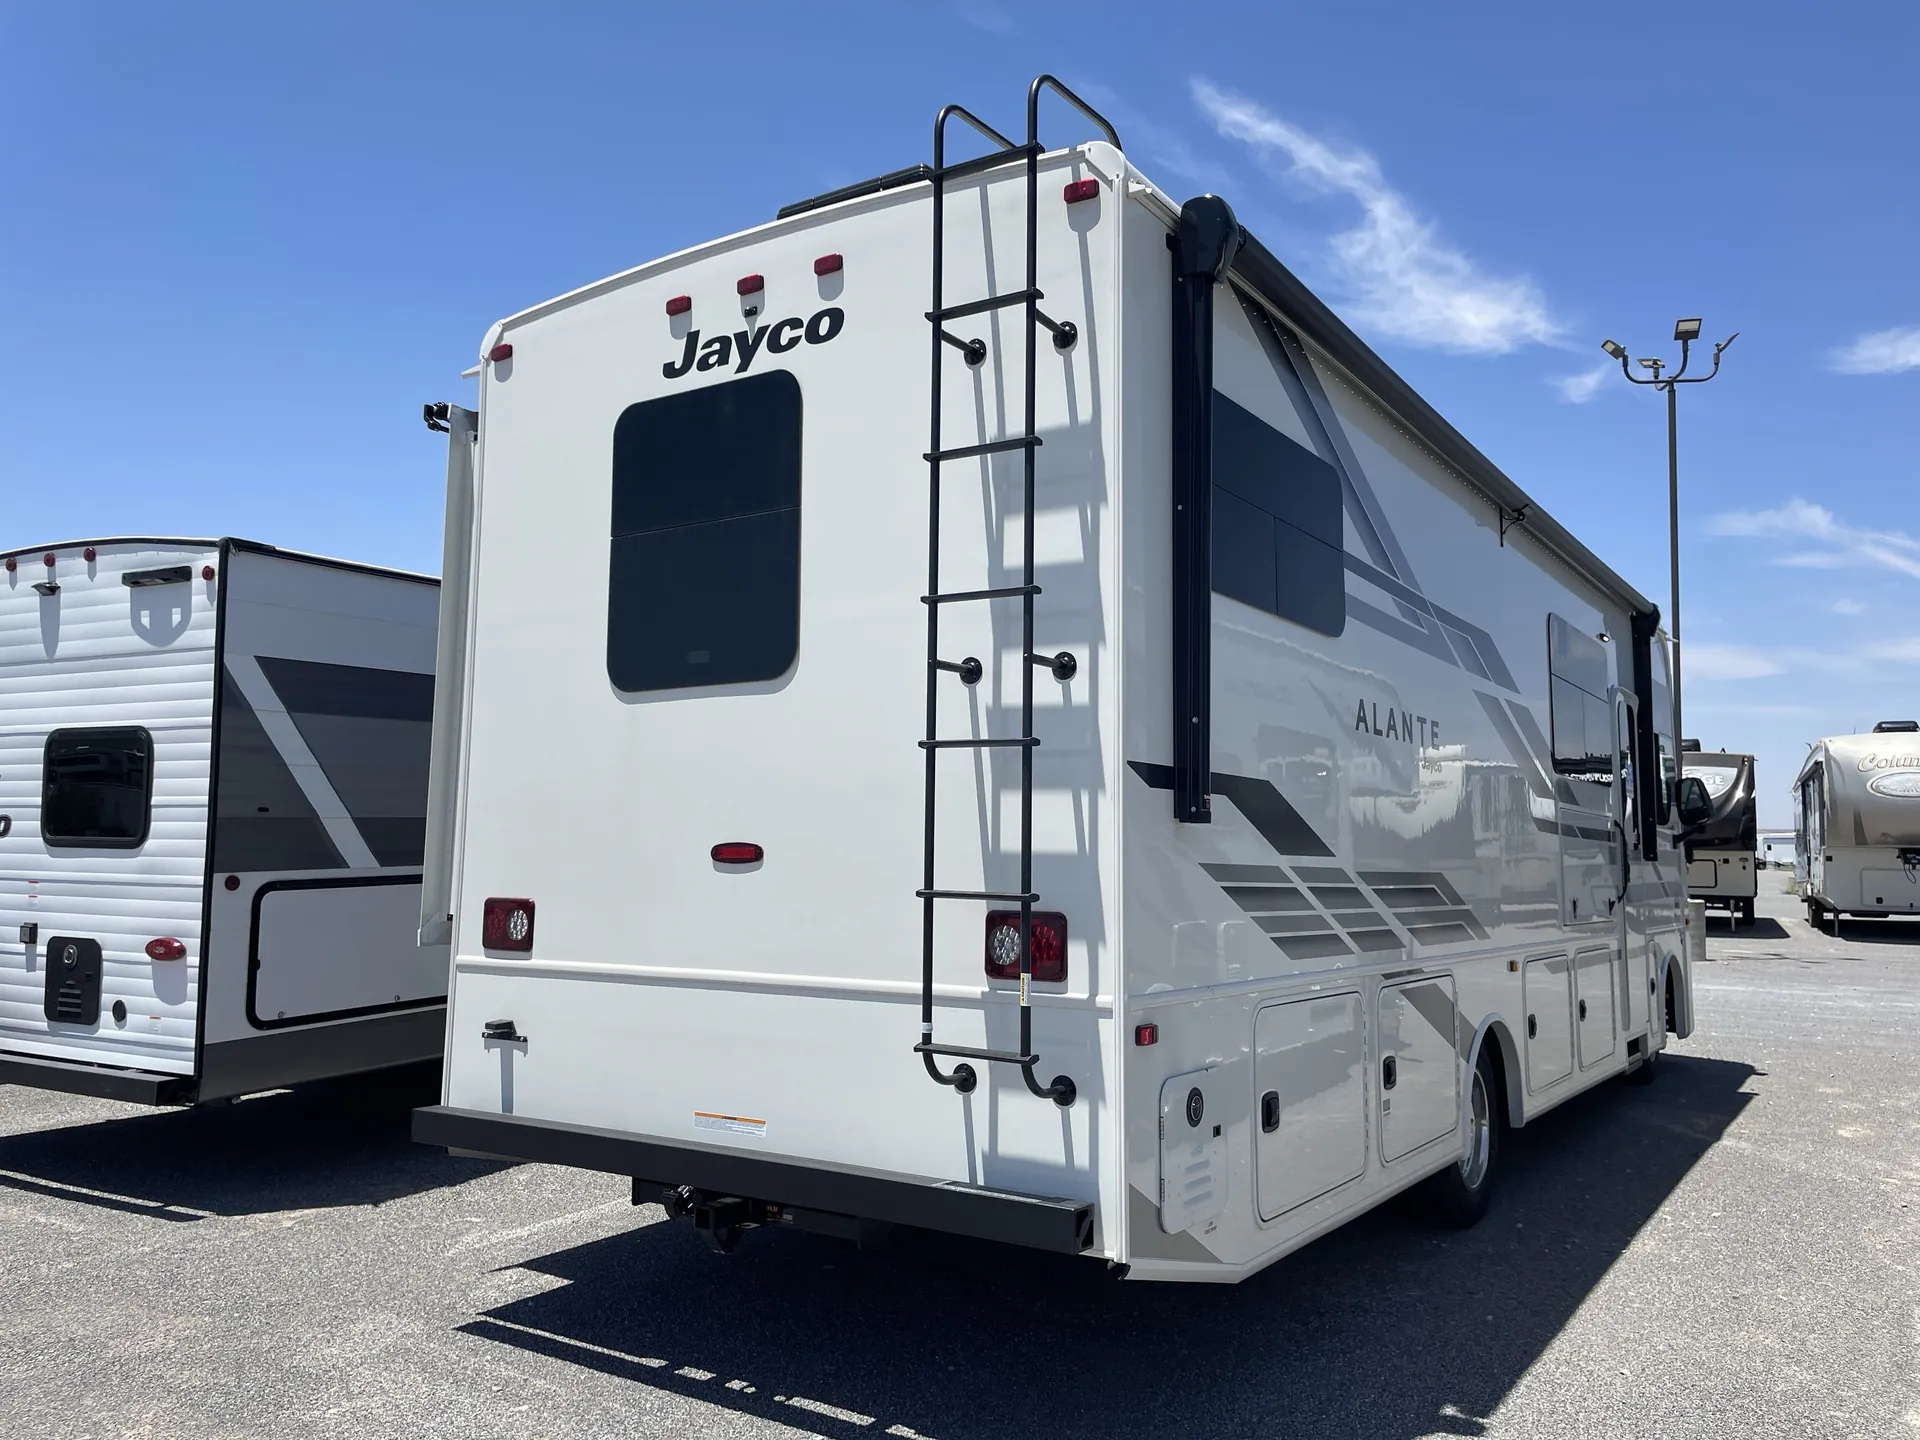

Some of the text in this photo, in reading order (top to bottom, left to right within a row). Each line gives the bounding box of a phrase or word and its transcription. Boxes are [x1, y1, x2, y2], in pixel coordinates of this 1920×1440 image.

[662, 307, 845, 379] Jayco
[1355, 699, 1440, 751] ALANTE
[1421, 756, 1443, 774] Jayco
